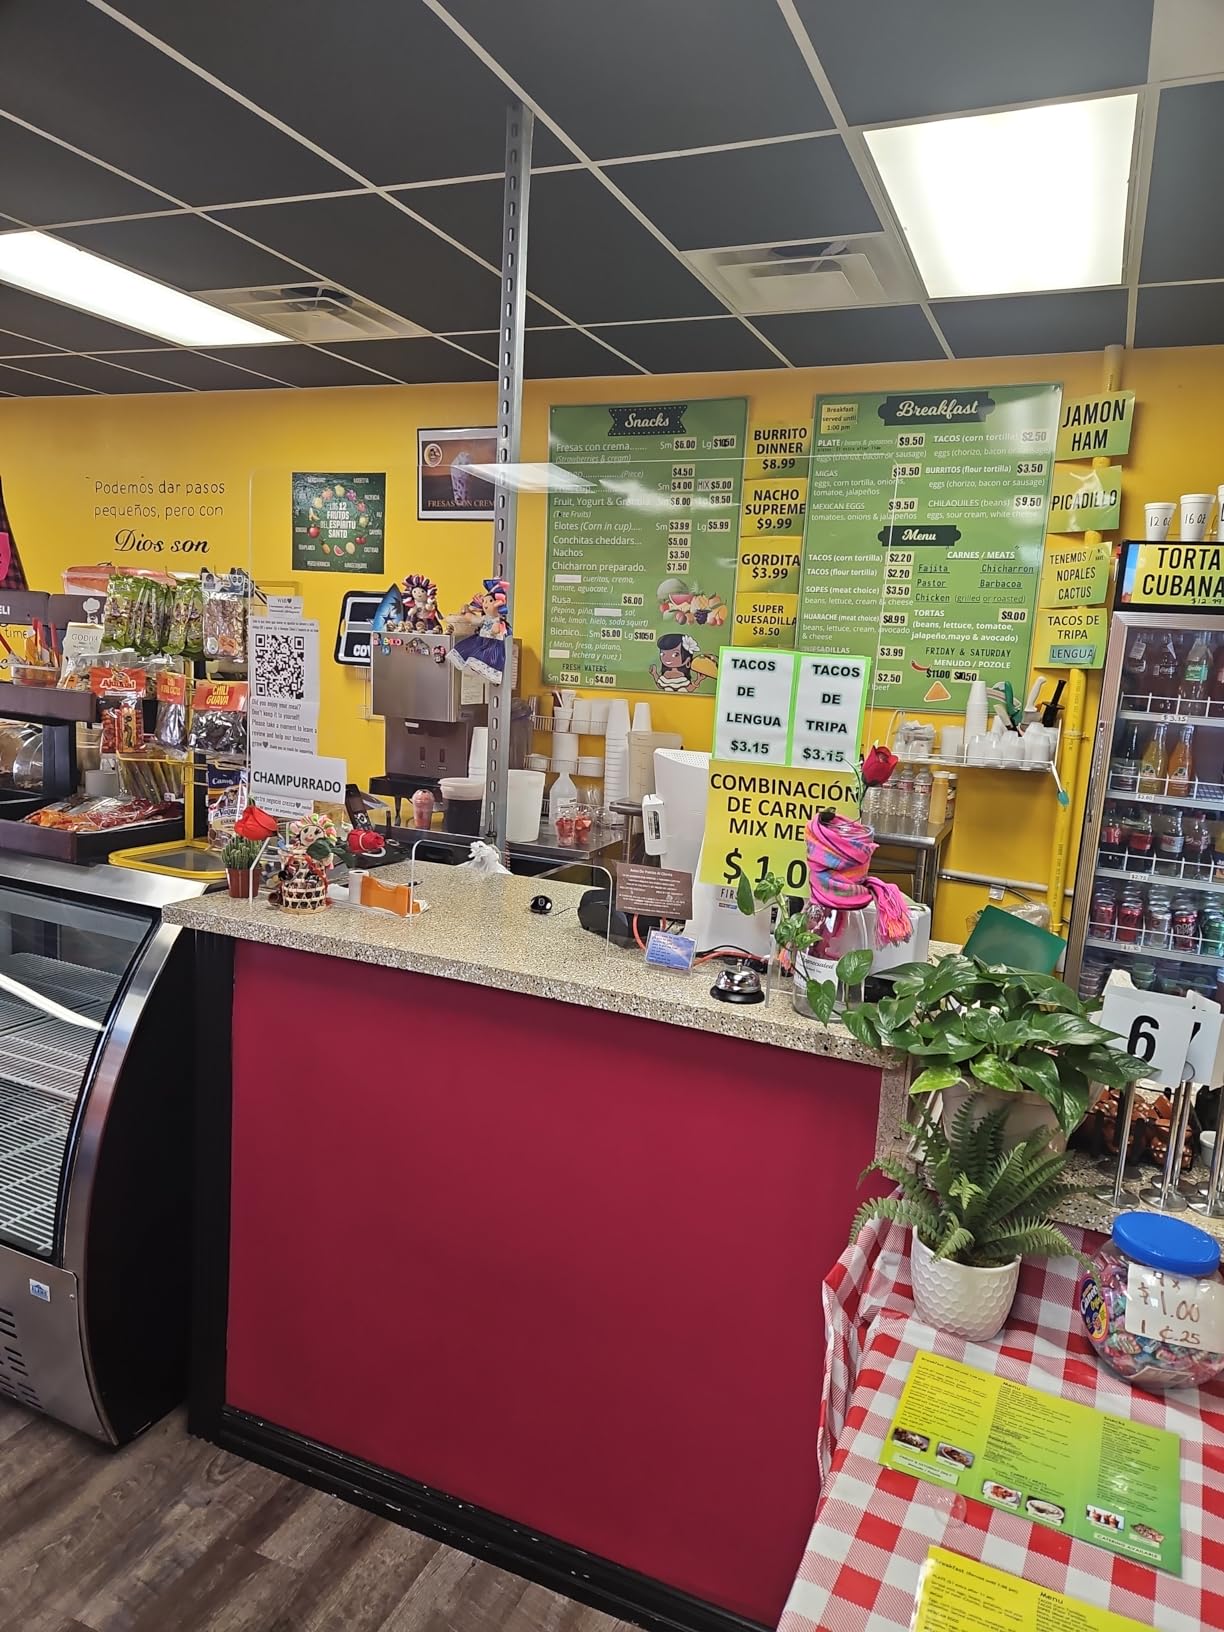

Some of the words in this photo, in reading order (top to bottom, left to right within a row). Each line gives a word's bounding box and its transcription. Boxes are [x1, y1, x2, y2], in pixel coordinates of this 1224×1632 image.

[896, 400, 978, 422] Breakfast
[1062, 398, 1126, 428] JAMON
[625, 412, 670, 428] Snacks
[754, 428, 807, 441] BURRITO
[934, 434, 960, 442] TACOS
[962, 434, 984, 442] (corn
[1071, 428, 1109, 452] HAM
[556, 444, 583, 452] Fresas
[660, 442, 672, 450] Sm
[702, 440, 712, 450] Lg
[818, 439, 842, 447] PLATE
[900, 436, 924, 446] $9.50
[757, 442, 803, 456] DINNER
[934, 450, 950, 458] eggs
[762, 458, 796, 471] $8.99
[926, 466, 961, 474] BURRITOS
[962, 465, 982, 474] (flour
[984, 464, 1012, 473] tortilla)
[1018, 464, 1044, 473] $3.50
[672, 468, 693, 477] $4.50
[95, 480, 153, 495] Podemos
[159, 480, 181, 495] dar
[186, 482, 226, 498] pasos
[710, 480, 732, 490] $5.00
[928, 482, 945, 490] eggs
[1012, 479, 1045, 488] sausage)
[753, 489, 800, 502] NACHO
[1051, 489, 1117, 512] PICADILLO
[339, 502, 347, 510] 12
[428, 500, 456, 508] FRESAS
[577, 498, 604, 508] Yogurt
[606, 498, 614, 506] &
[812, 502, 844, 510] MEXICAN
[847, 502, 865, 510] EGGS
[888, 500, 914, 510] $9.50
[1015, 497, 1042, 506] $9.50
[94, 504, 161, 520] pequeños,
[166, 506, 195, 520] pero
[200, 506, 224, 517] con
[327, 510, 350, 520] FRUTOS
[745, 503, 806, 516] SUPREME
[757, 517, 792, 530] $9.99
[1150, 516, 1160, 528] 12
[1185, 514, 1194, 524] 16
[554, 522, 579, 530] Elotes
[580, 522, 602, 531] (Corn
[669, 522, 690, 530] $3.99
[697, 522, 706, 532] Lg
[708, 522, 728, 530] $5.99
[328, 529, 348, 538] SANTO
[902, 528, 936, 541] Menu
[114, 528, 164, 553] Dios
[170, 538, 210, 554] son
[553, 536, 594, 544] Conchitas
[668, 538, 688, 546] $5.00
[553, 549, 584, 558] Nachos
[669, 551, 690, 560] $3.50
[742, 554, 801, 566] GORDITA
[808, 554, 832, 562] TACOS
[834, 554, 852, 562] (corn
[890, 553, 912, 562] $2.20
[947, 551, 980, 559] CARNES
[986, 552, 1016, 560] MEATS
[1050, 551, 1087, 565] TENEMOS
[1158, 547, 1220, 570] TORTA
[552, 562, 597, 572] Chicharron
[666, 562, 687, 571] $7.50
[918, 564, 948, 573] Fajita
[982, 564, 1034, 573] Chicharron
[752, 566, 788, 580] $3.99
[807, 568, 830, 576] TACOS
[830, 568, 850, 577] (flour
[852, 569, 878, 578] tortilla)
[888, 569, 910, 578] $2.20
[1056, 566, 1096, 583] NOPALES
[918, 579, 946, 587] Pastor
[980, 580, 1022, 588] Barbacoa
[1142, 574, 1224, 598] CUBANA
[806, 586, 828, 594] SOPES
[830, 586, 852, 595] (meat
[854, 586, 880, 595] choice)
[886, 586, 910, 596] $3.50
[1058, 586, 1092, 600] CACTUS
[624, 596, 642, 604] $6.00
[916, 594, 950, 602] Chicken
[752, 604, 784, 614] SUPER
[736, 614, 798, 626] QUESADILLA
[839, 614, 856, 622] (meat
[914, 609, 945, 617] TORTAS
[1002, 610, 1026, 621] $9.00
[1048, 616, 1084, 627] TACOS
[1086, 616, 1100, 626] DE
[752, 626, 780, 637] $8.50
[1057, 629, 1088, 640] TRIPA
[808, 634, 833, 642] cheese
[980, 634, 1018, 644] avocado)
[880, 648, 904, 658] $3.99
[926, 647, 956, 656] FRIDAY
[959, 648, 966, 656] &
[970, 648, 1012, 658] SATURDAY
[1052, 648, 1094, 660] LENGUA
[584, 664, 608, 672] WATERS
[731, 658, 776, 671] TACOS
[978, 661, 1011, 669] POZOLE
[812, 664, 860, 678] TACOS
[561, 674, 579, 683] $2.50
[596, 675, 614, 684] $4.00
[878, 673, 900, 683] $2.50
[737, 686, 755, 697] DE
[821, 693, 842, 705] DE
[726, 712, 782, 727] LENGUA
[806, 720, 848, 734] TRIPA
[730, 739, 770, 754] $3.15
[802, 748, 844, 763] $3.15
[253, 771, 342, 794] CHAMPURRADO
[711, 773, 859, 804] COMBINACIÓN
[727, 796, 751, 814] DE
[729, 818, 768, 838] MIX
[1127, 1015, 1160, 1064] 6
[1138, 1282, 1200, 1323] $1.00
[1040, 1592, 1064, 1605] Menu
